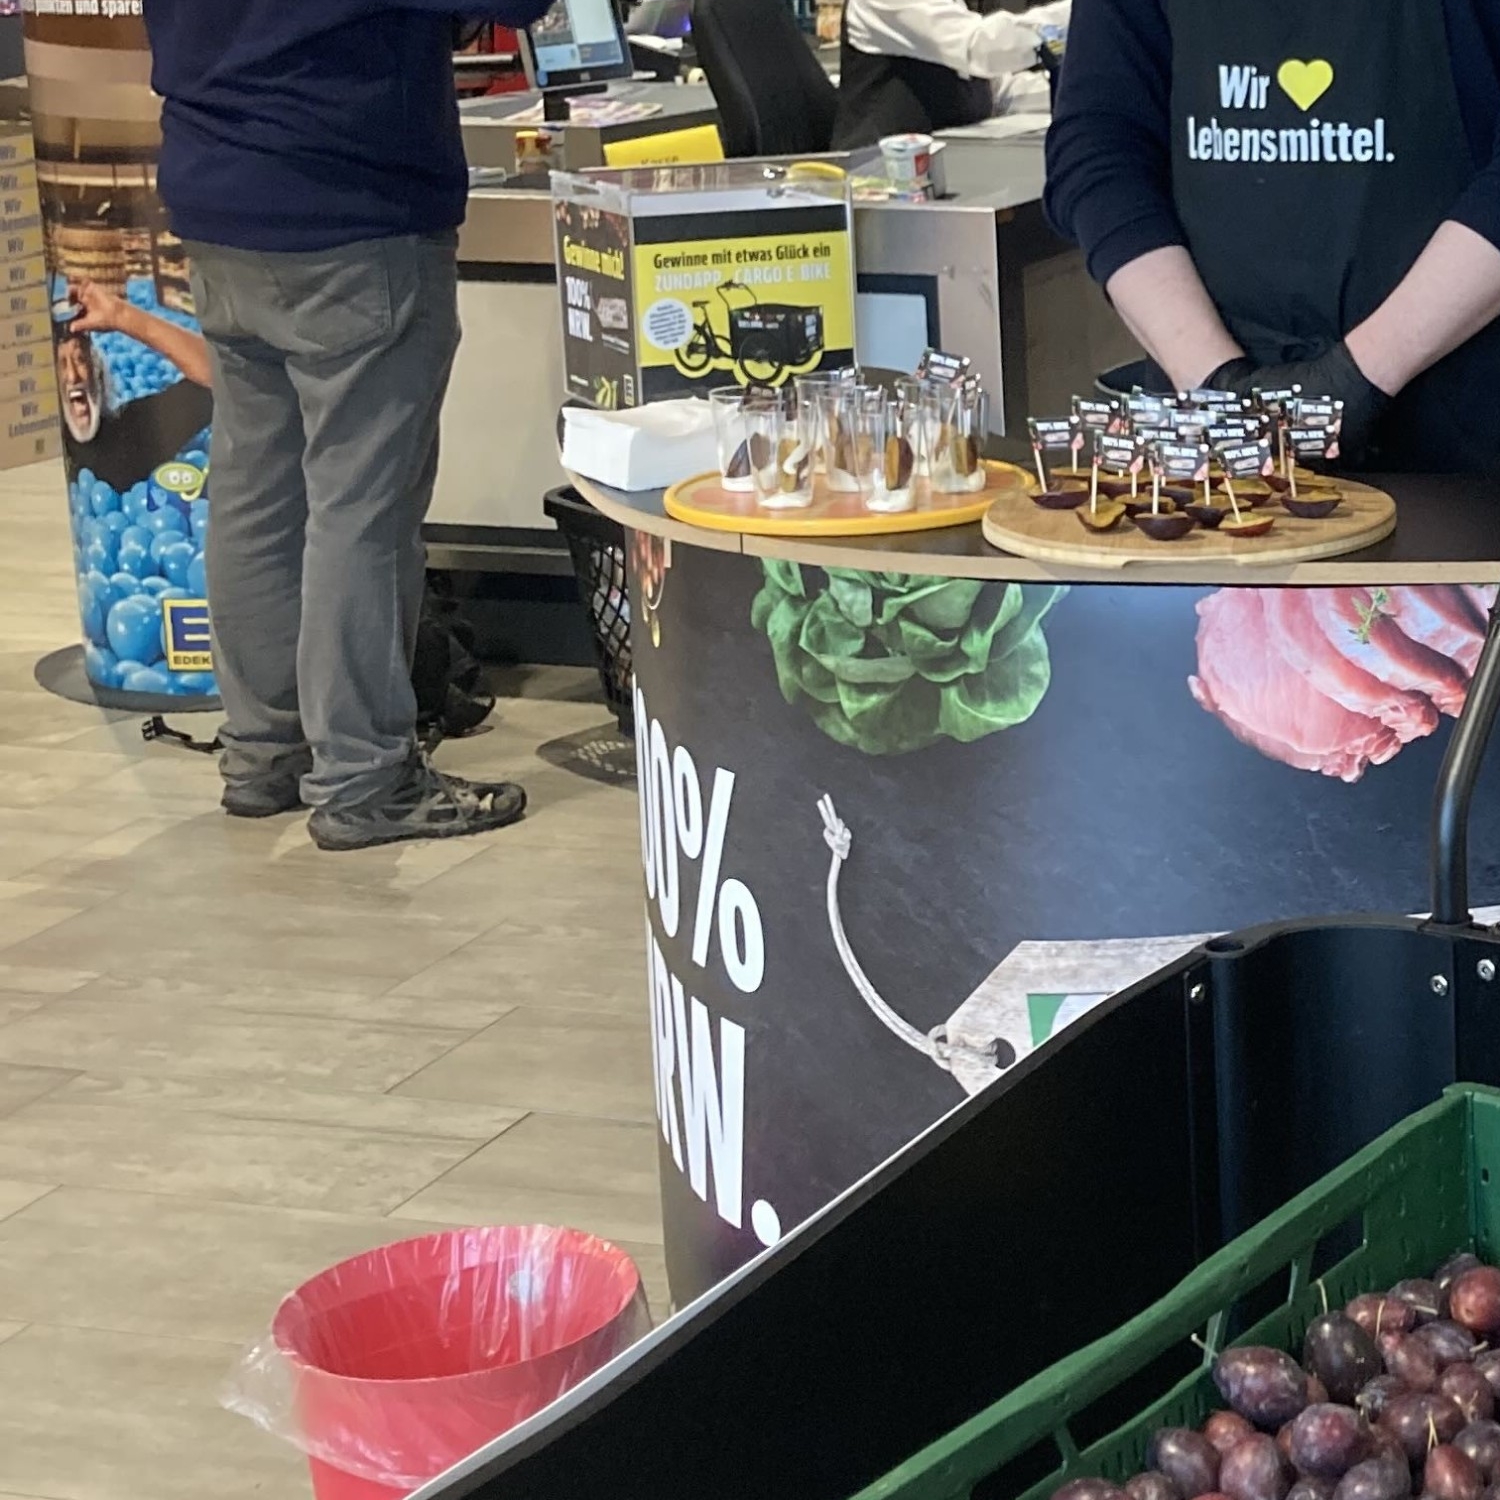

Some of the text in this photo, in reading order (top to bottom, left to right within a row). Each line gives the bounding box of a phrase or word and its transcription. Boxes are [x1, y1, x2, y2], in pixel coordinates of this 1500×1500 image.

[101, 0, 143, 19] spare
[1219, 64, 1270, 110] Wir
[1187, 116, 1395, 162] Lebensmittel.
[654, 242, 830, 269] Gewinne mit etwas Glück ein
